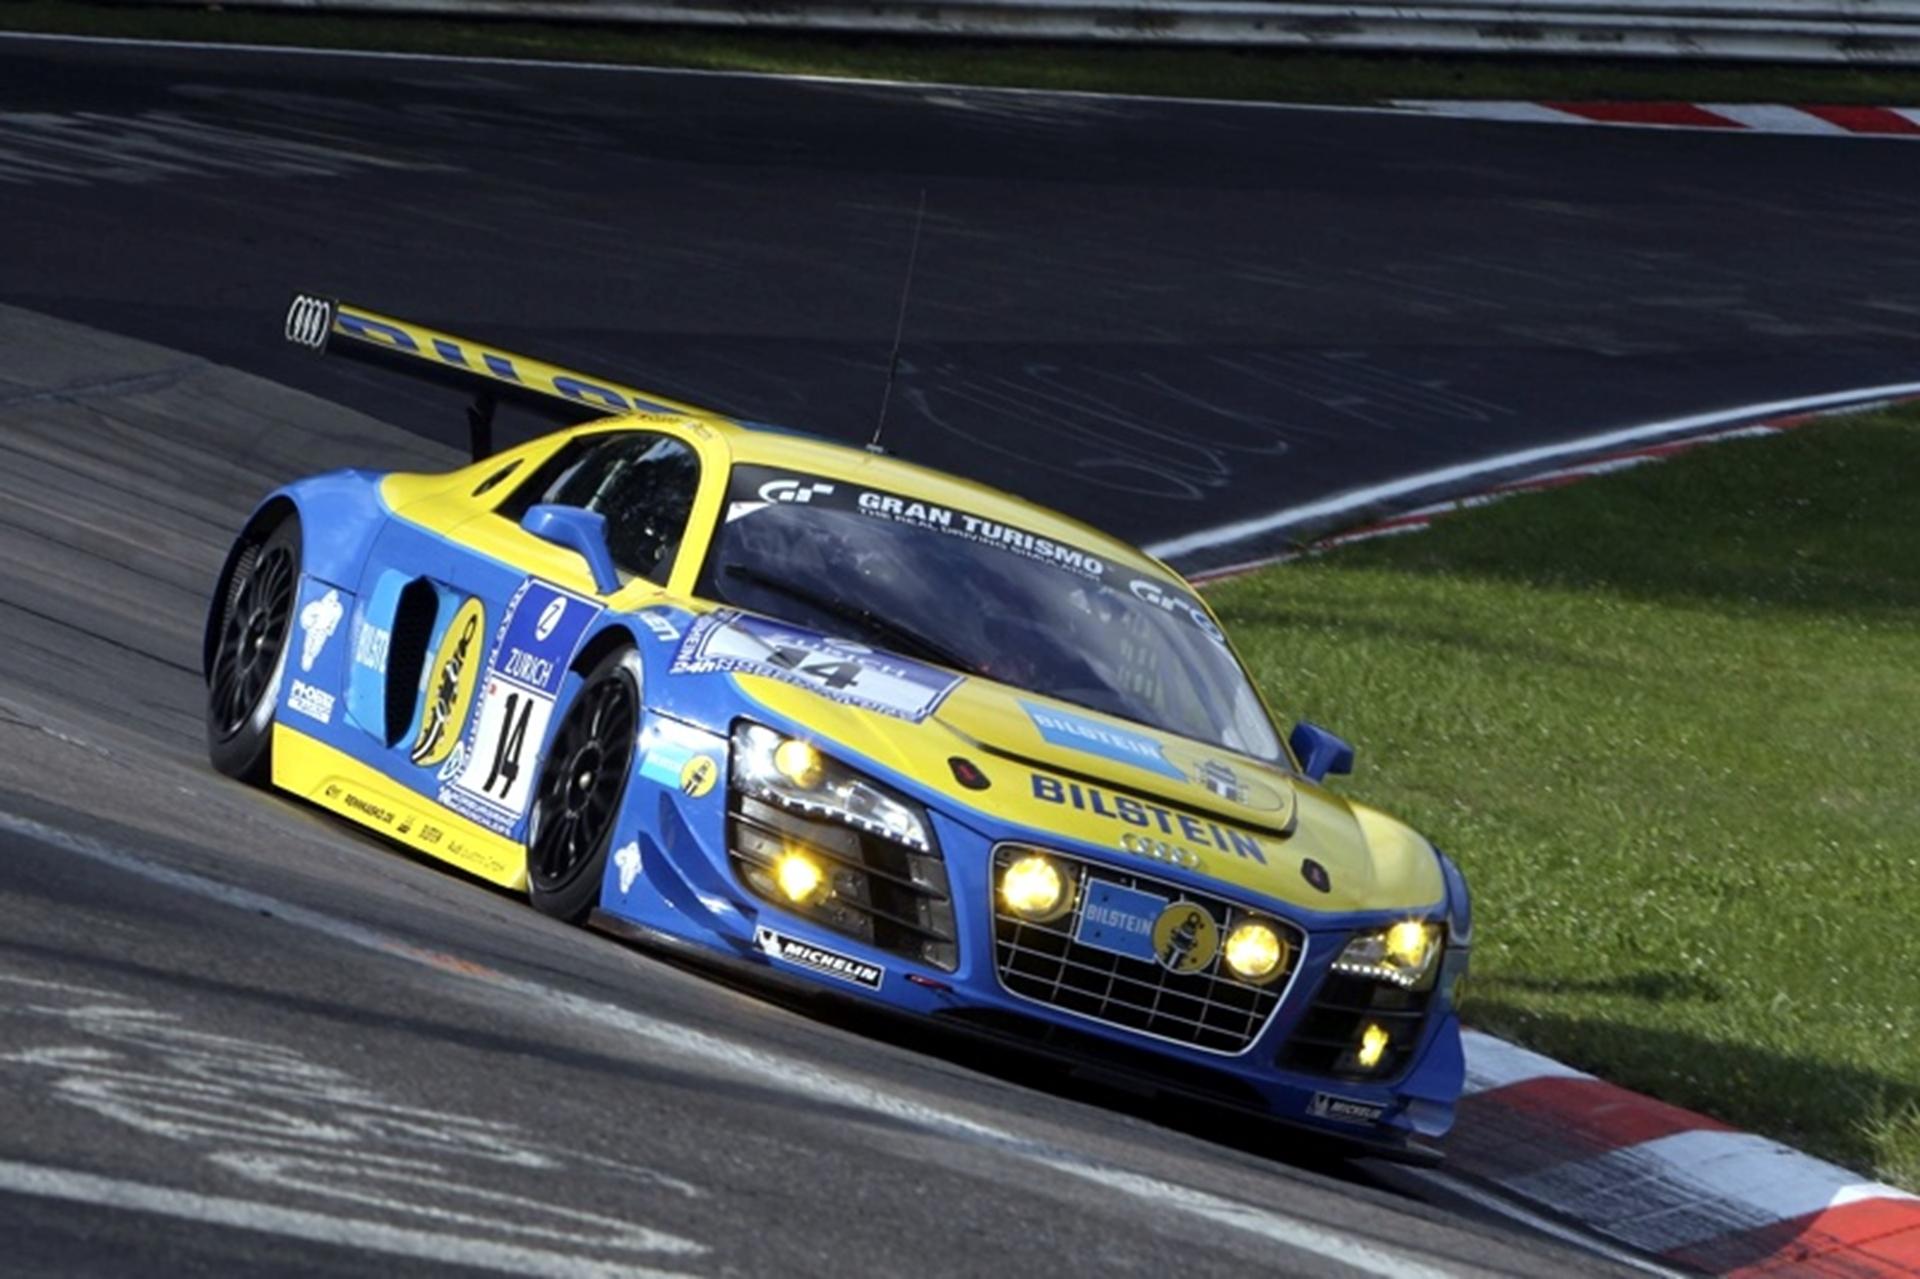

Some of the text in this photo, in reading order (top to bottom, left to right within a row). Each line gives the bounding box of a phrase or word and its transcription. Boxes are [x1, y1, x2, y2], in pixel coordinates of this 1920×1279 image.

[858, 492, 1104, 575] GRAN TURISMO
[504, 648, 554, 689] ZURICH
[482, 692, 534, 800] 14
[1034, 713, 1162, 759] BILSTEIN
[1031, 774, 1268, 866] BILSTEIN
[1086, 904, 1153, 937] BILSTEIN
[784, 942, 879, 980] MICHELIN
